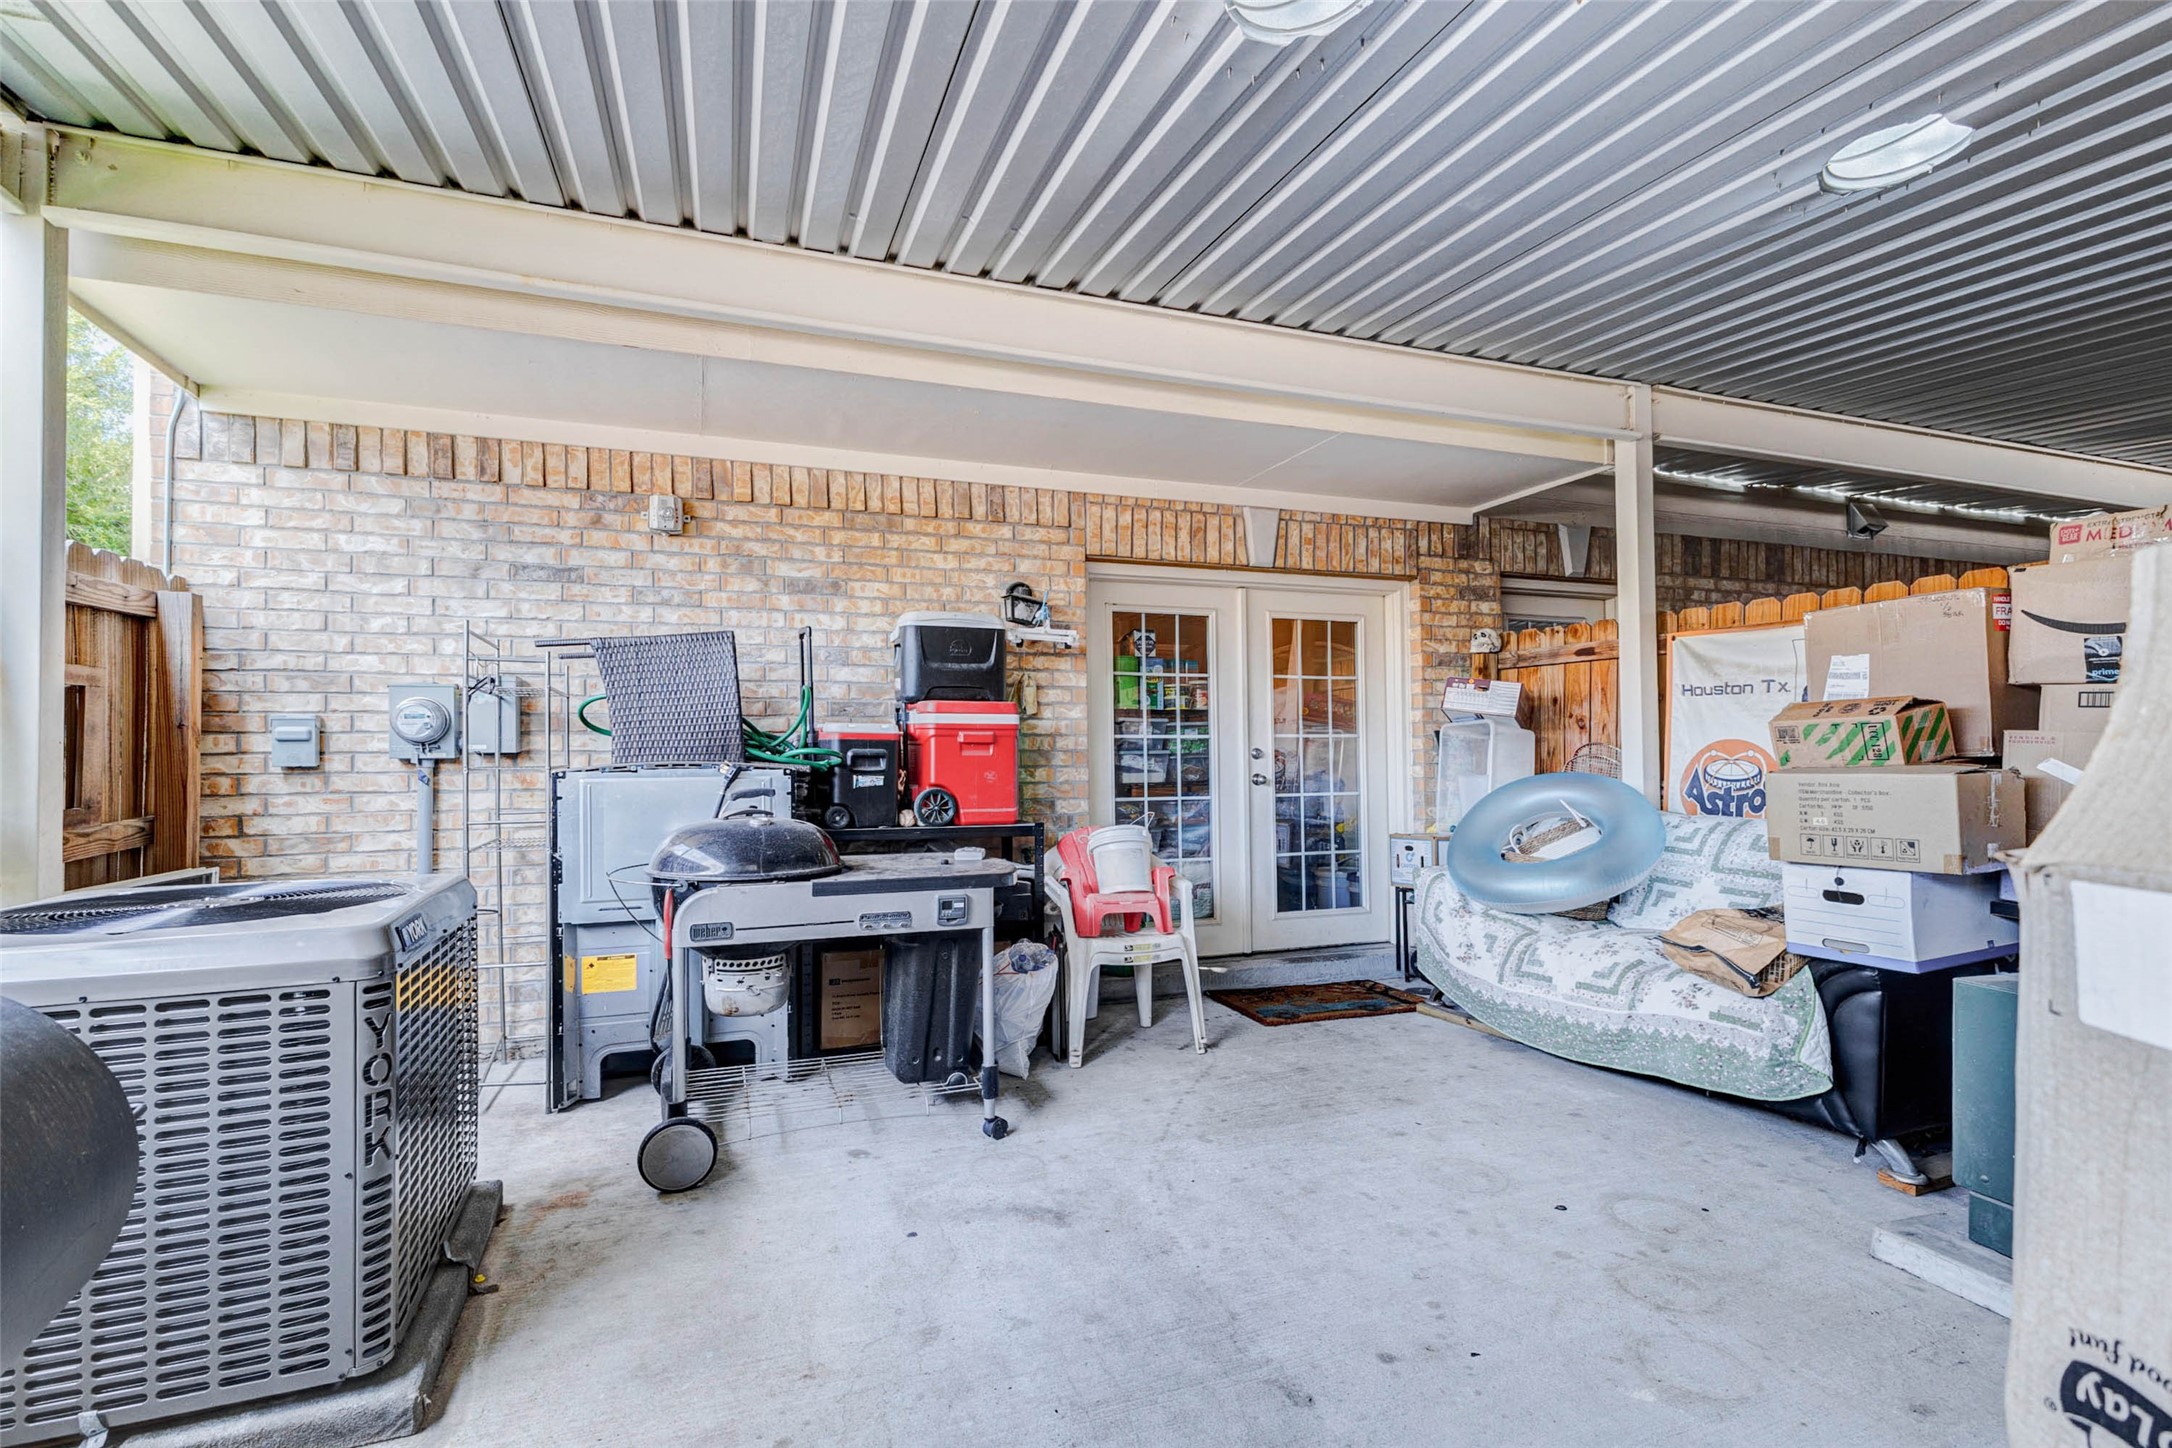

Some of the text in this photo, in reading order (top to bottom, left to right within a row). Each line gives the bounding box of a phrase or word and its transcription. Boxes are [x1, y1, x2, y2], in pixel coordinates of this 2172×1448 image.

[2092, 667, 2120, 677] prime
[1682, 682, 1754, 697] Houston
[1684, 764, 1767, 817] Astro
[406, 917, 428, 942] YORK
[693, 924, 721, 938] weber
[362, 1013, 393, 1166] YORK
[2069, 1327, 2123, 1364] fun!
